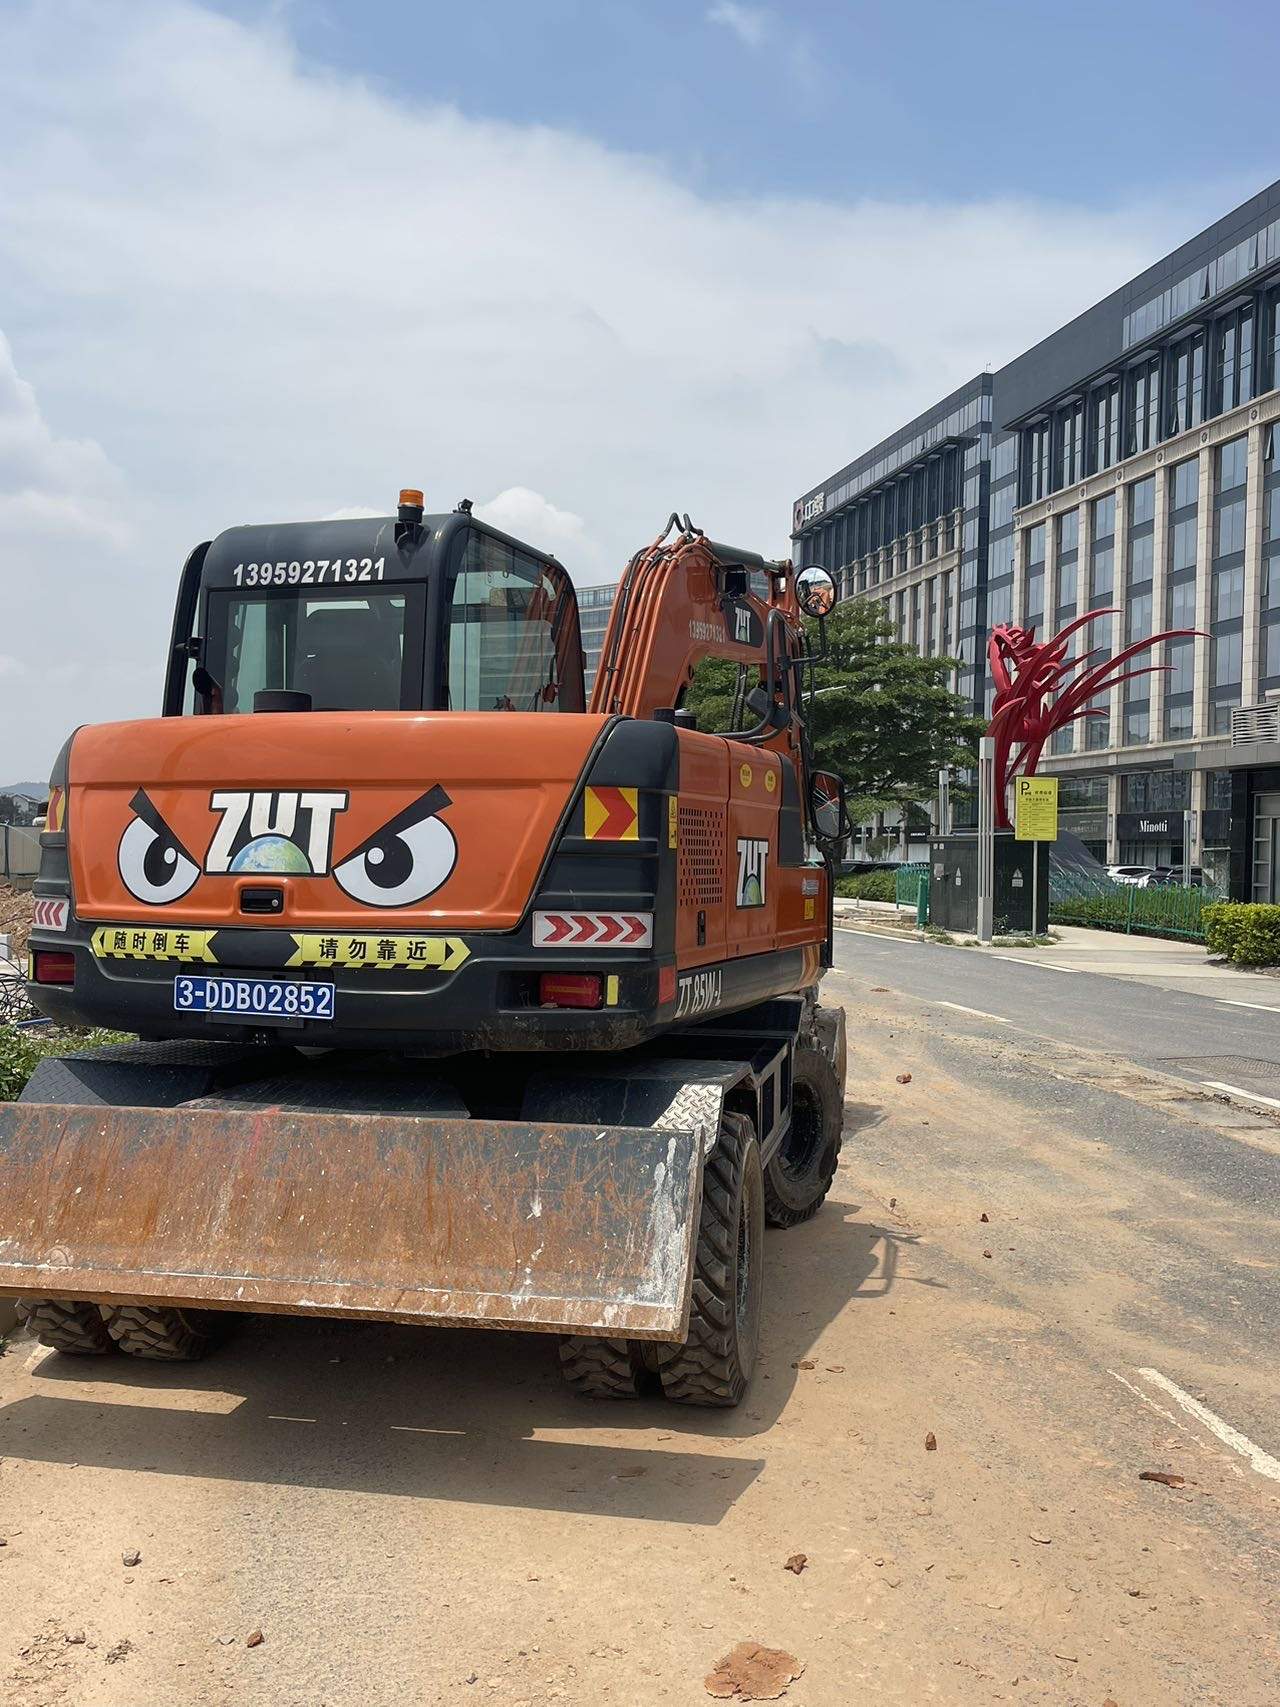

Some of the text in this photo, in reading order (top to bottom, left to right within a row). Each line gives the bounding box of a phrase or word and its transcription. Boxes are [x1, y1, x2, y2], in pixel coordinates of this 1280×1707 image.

[233, 557, 385, 586] 13959271321
[206, 792, 347, 874] ZUT
[1139, 820, 1168, 833] Minotti
[736, 840, 769, 907] ZUT
[113, 931, 190, 953] 随时倒车
[319, 937, 428, 961] 请勿靠近
[178, 980, 331, 1015] 3-DDB02852
